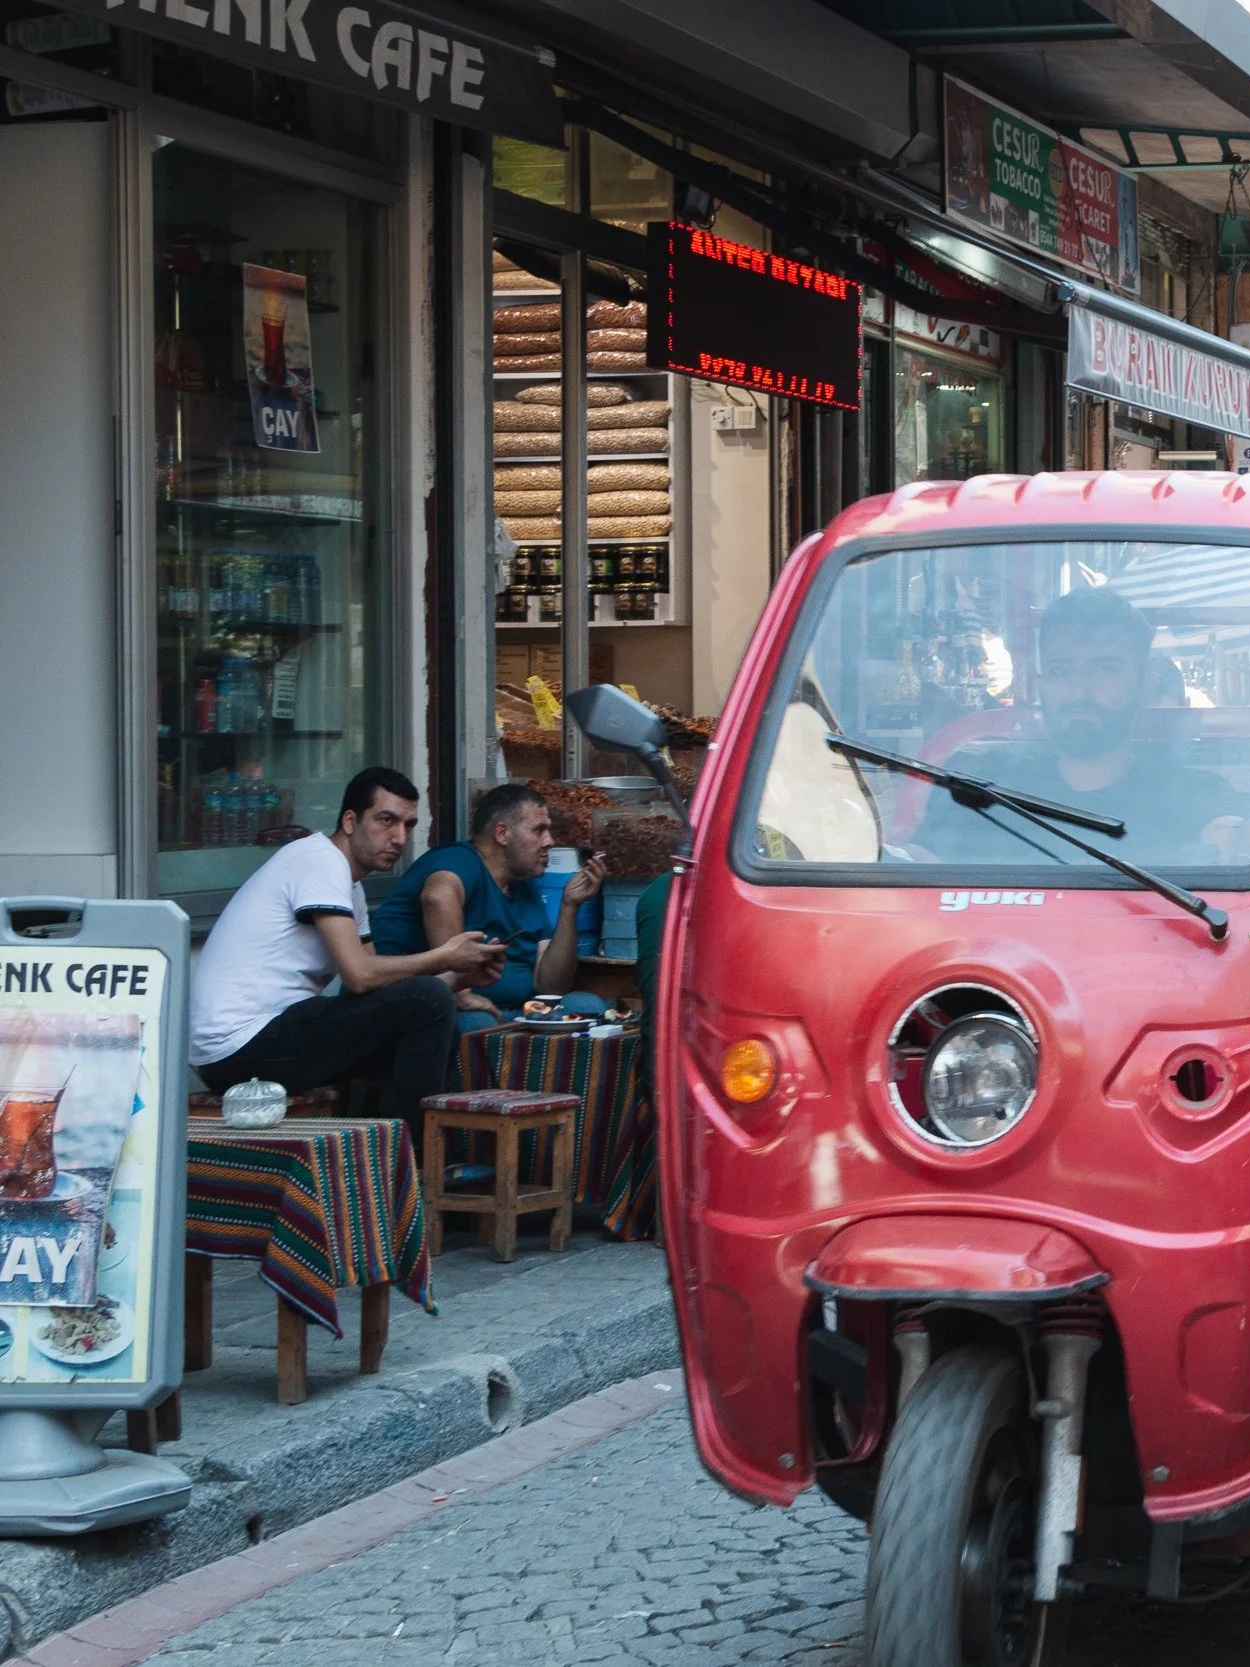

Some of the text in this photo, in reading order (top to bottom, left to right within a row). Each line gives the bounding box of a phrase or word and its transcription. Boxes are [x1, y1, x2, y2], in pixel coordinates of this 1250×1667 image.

[337, 7, 486, 110] CAFE
[992, 117, 1044, 173] CESUR
[994, 158, 1041, 200] TOBACCO
[1069, 157, 1115, 208] CESUR
[1092, 316, 1177, 399] BURAK
[261, 406, 299, 443] ÇAY
[939, 891, 1046, 912] yuki
[0, 962, 149, 999] NK CAFE
